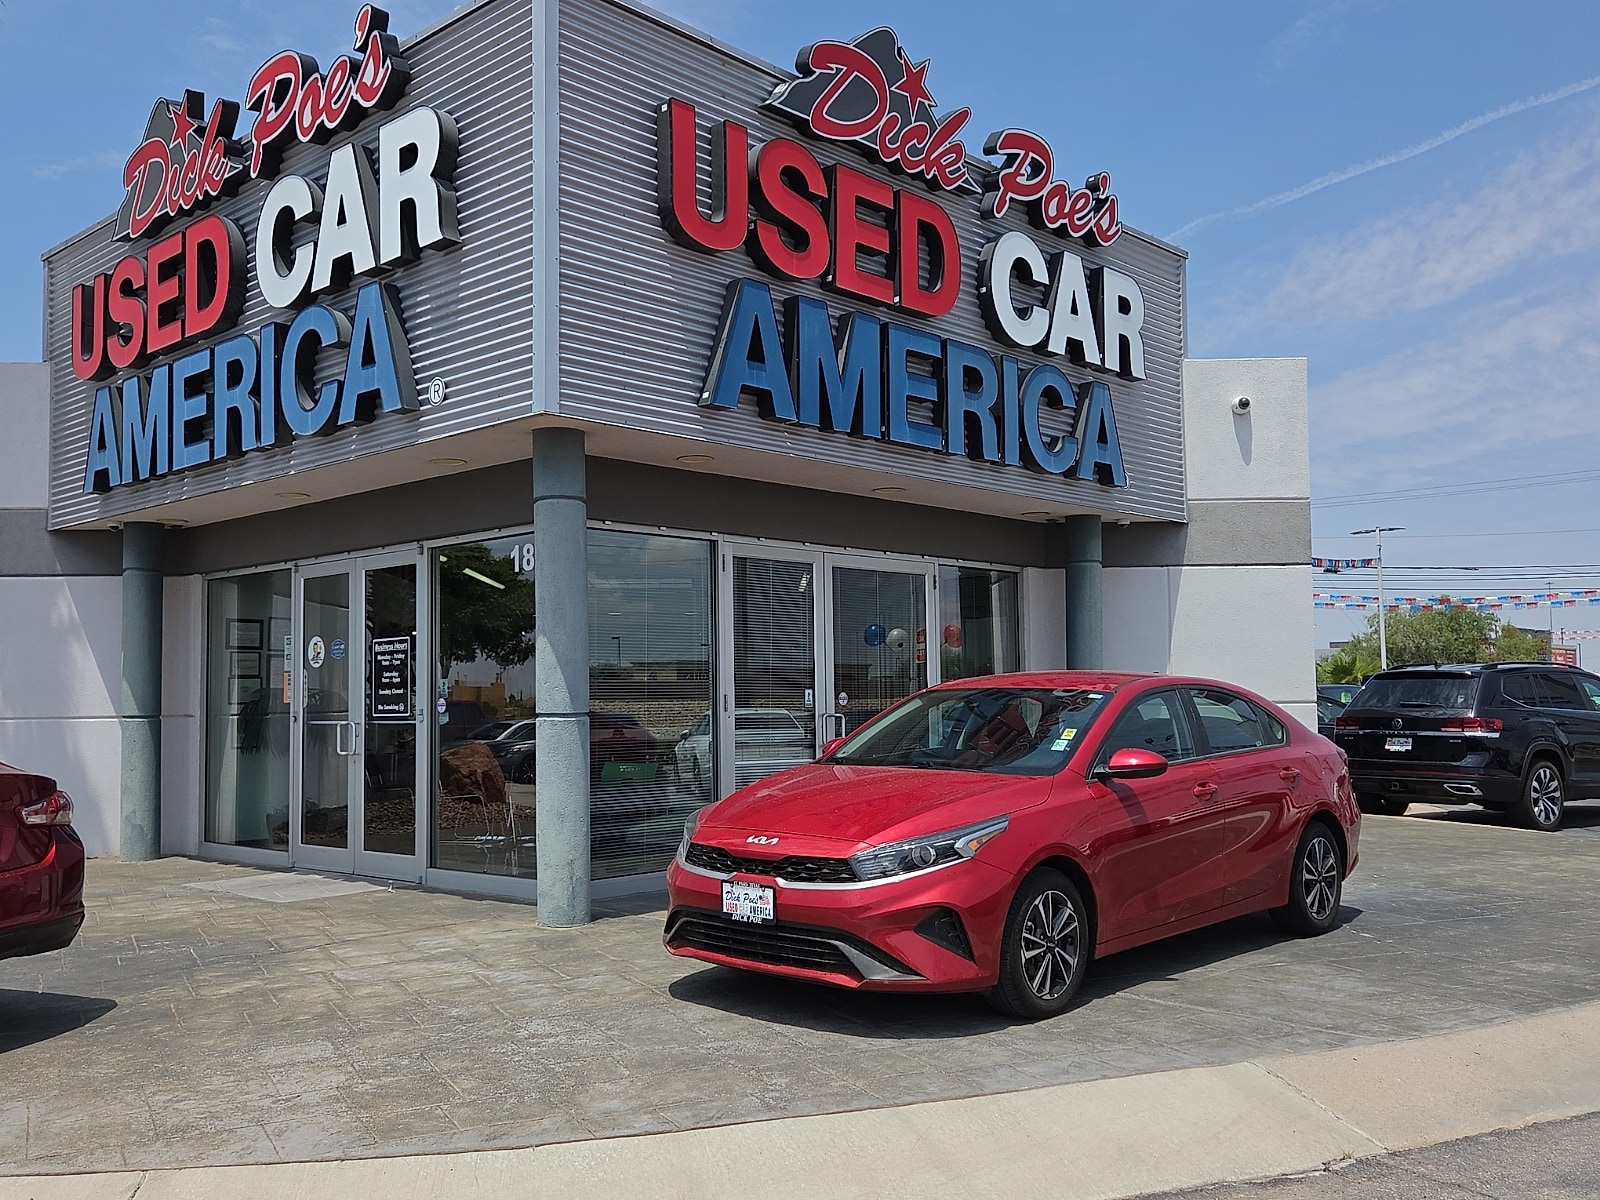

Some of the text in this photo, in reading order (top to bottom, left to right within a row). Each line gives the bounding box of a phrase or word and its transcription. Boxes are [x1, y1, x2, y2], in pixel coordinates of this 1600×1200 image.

[124, 3, 393, 239] Dick Poe's
[809, 40, 1123, 247] Dick Poe's
[71, 106, 445, 381] USED CAR
[669, 98, 1146, 382] USED CAR
[84, 282, 402, 495] AMERICA
[711, 280, 1128, 487] AMERICA
[375, 643, 393, 652] Business
[725, 890, 740, 902] Dick
[725, 902, 739, 912] USED
[749, 905, 771, 917] AMERICA
[732, 914, 763, 924] DICK POE
